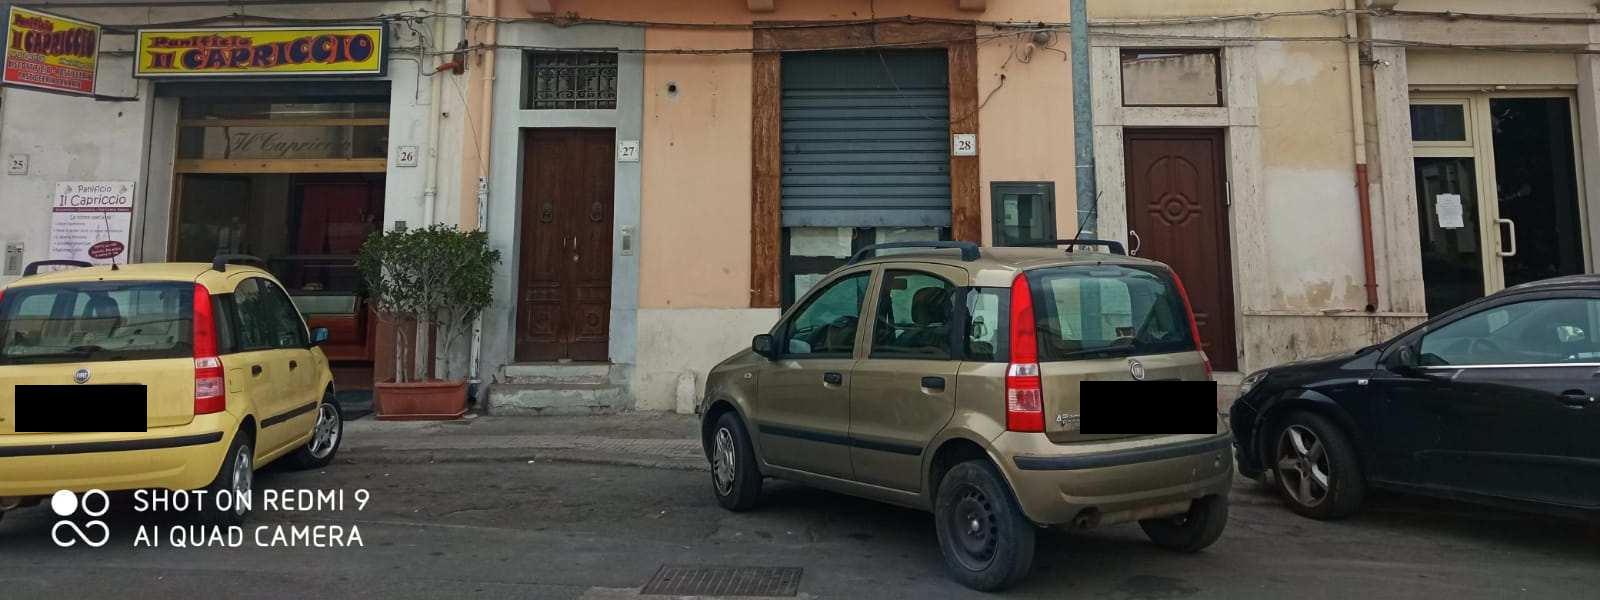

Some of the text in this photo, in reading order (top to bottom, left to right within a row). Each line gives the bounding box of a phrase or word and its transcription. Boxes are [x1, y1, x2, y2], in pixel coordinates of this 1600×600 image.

[148, 35, 252, 48] Panificio
[181, 33, 374, 70] CAPRICCIO
[959, 140, 971, 150] 28
[401, 151, 413, 161] 26
[623, 146, 635, 157] 27
[11, 160, 24, 170] 25
[78, 184, 112, 193] Panificio
[59, 194, 127, 207] Il Capriccio
